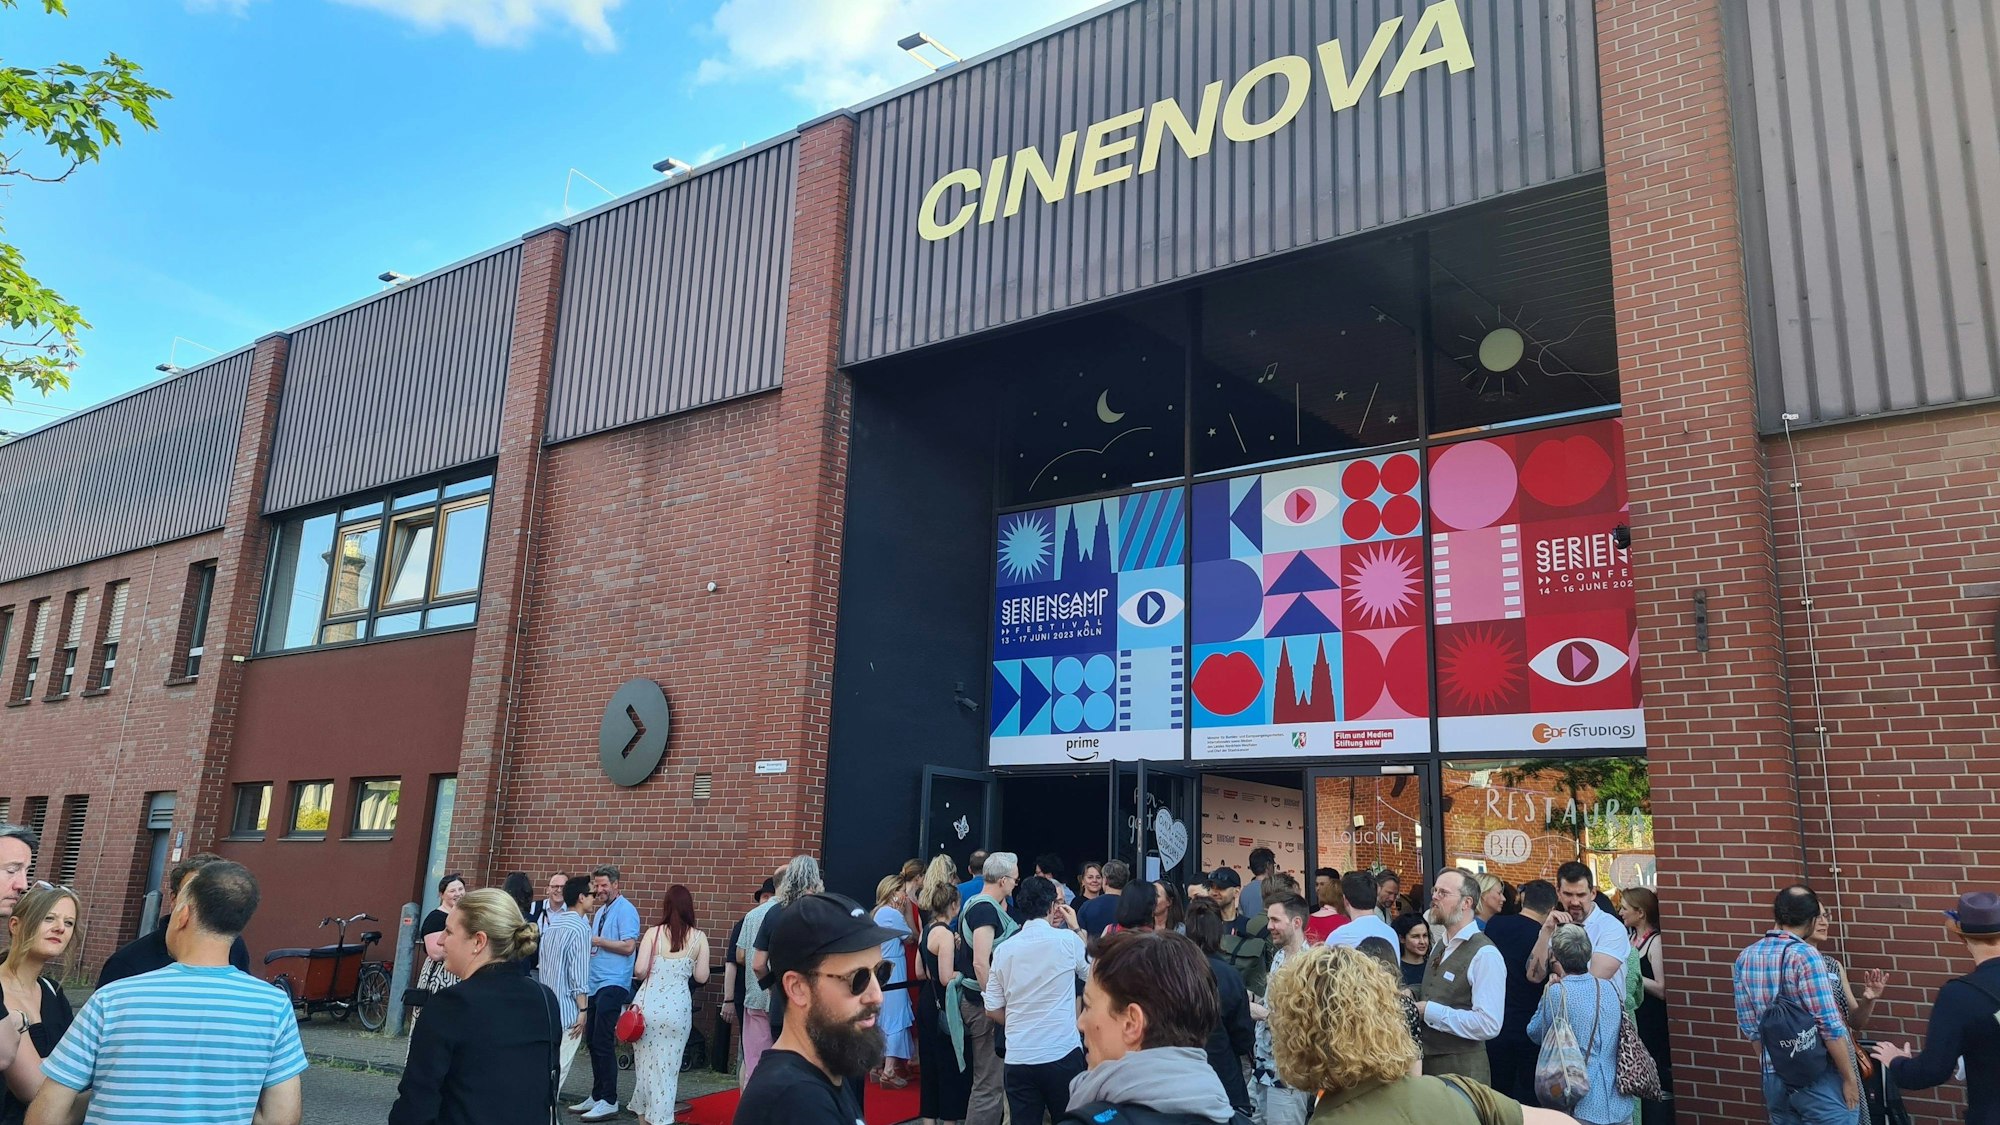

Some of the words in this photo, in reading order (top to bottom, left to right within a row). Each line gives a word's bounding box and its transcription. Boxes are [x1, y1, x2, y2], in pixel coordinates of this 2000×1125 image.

[918, 0, 1475, 241] CINENOVA
[1536, 533, 1632, 573] SERIEN
[1563, 585, 1574, 593] 16
[1579, 581, 1608, 592] JUNE
[1001, 588, 1109, 626] SERIENCAMP
[1015, 618, 1102, 634] FESTIVAL
[1001, 637, 1010, 645] 13
[1019, 635, 1027, 643] 17
[1030, 633, 1050, 642] JUNI
[1053, 630, 1074, 640] 2023
[1077, 627, 1102, 638] KÖLN
[1335, 732, 1352, 740] Film
[1352, 731, 1366, 739] und
[1366, 730, 1393, 739] Medien
[1573, 725, 1631, 737] STUDIOS
[1066, 736, 1099, 752] prime
[1335, 740, 1363, 748] Stiftung
[1486, 789, 1644, 831] RESTAURA
[1333, 831, 1399, 844] LOUCINE
[1490, 834, 1527, 858] BIO
